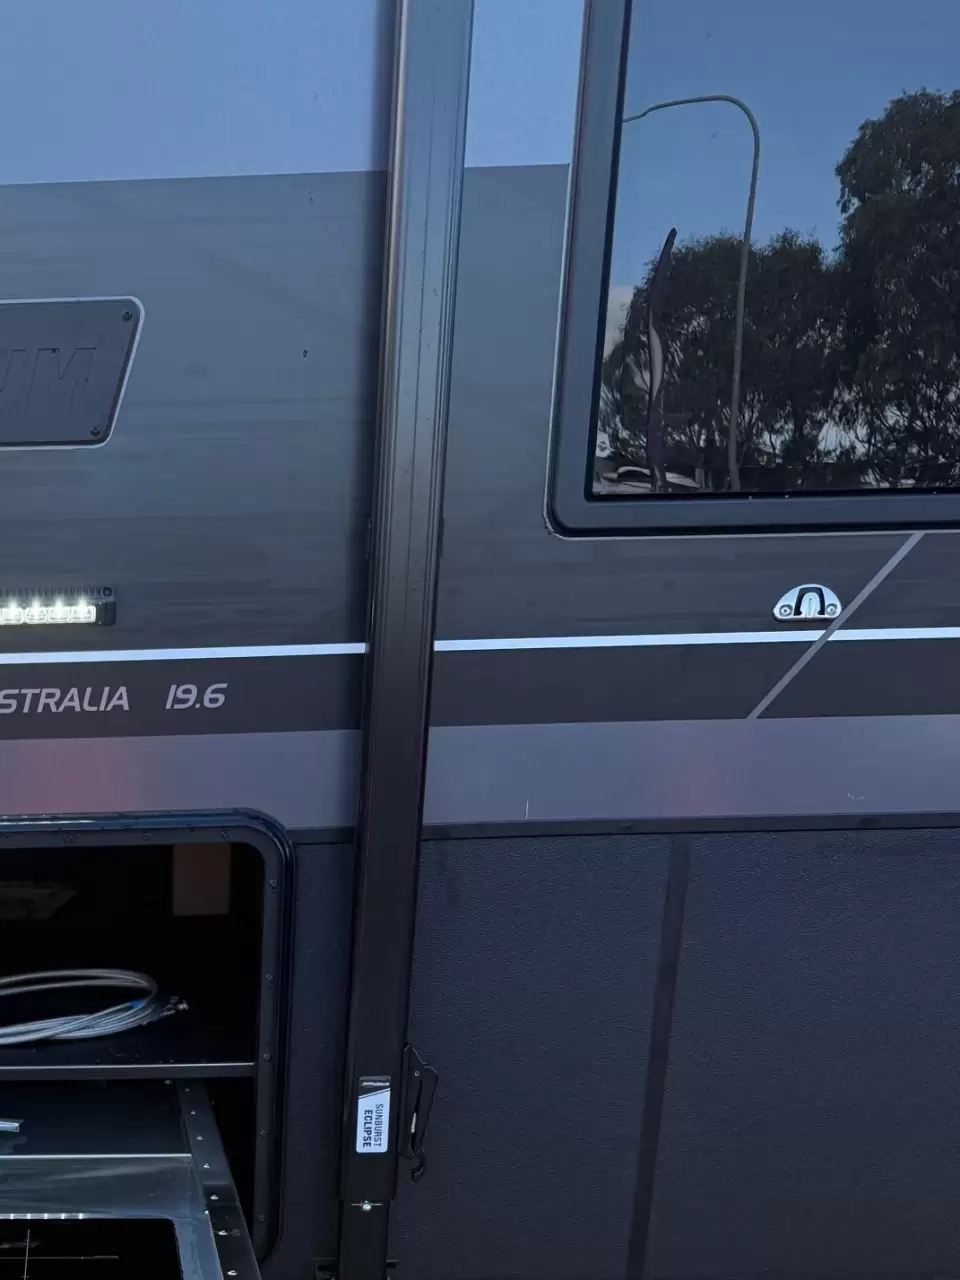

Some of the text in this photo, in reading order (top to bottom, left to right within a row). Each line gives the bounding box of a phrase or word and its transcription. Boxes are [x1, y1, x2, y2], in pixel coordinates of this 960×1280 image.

[164, 683, 228, 710] 19.6
[362, 1109, 374, 1148] ECLIPSE
[373, 1103, 384, 1148] SUNBURST
